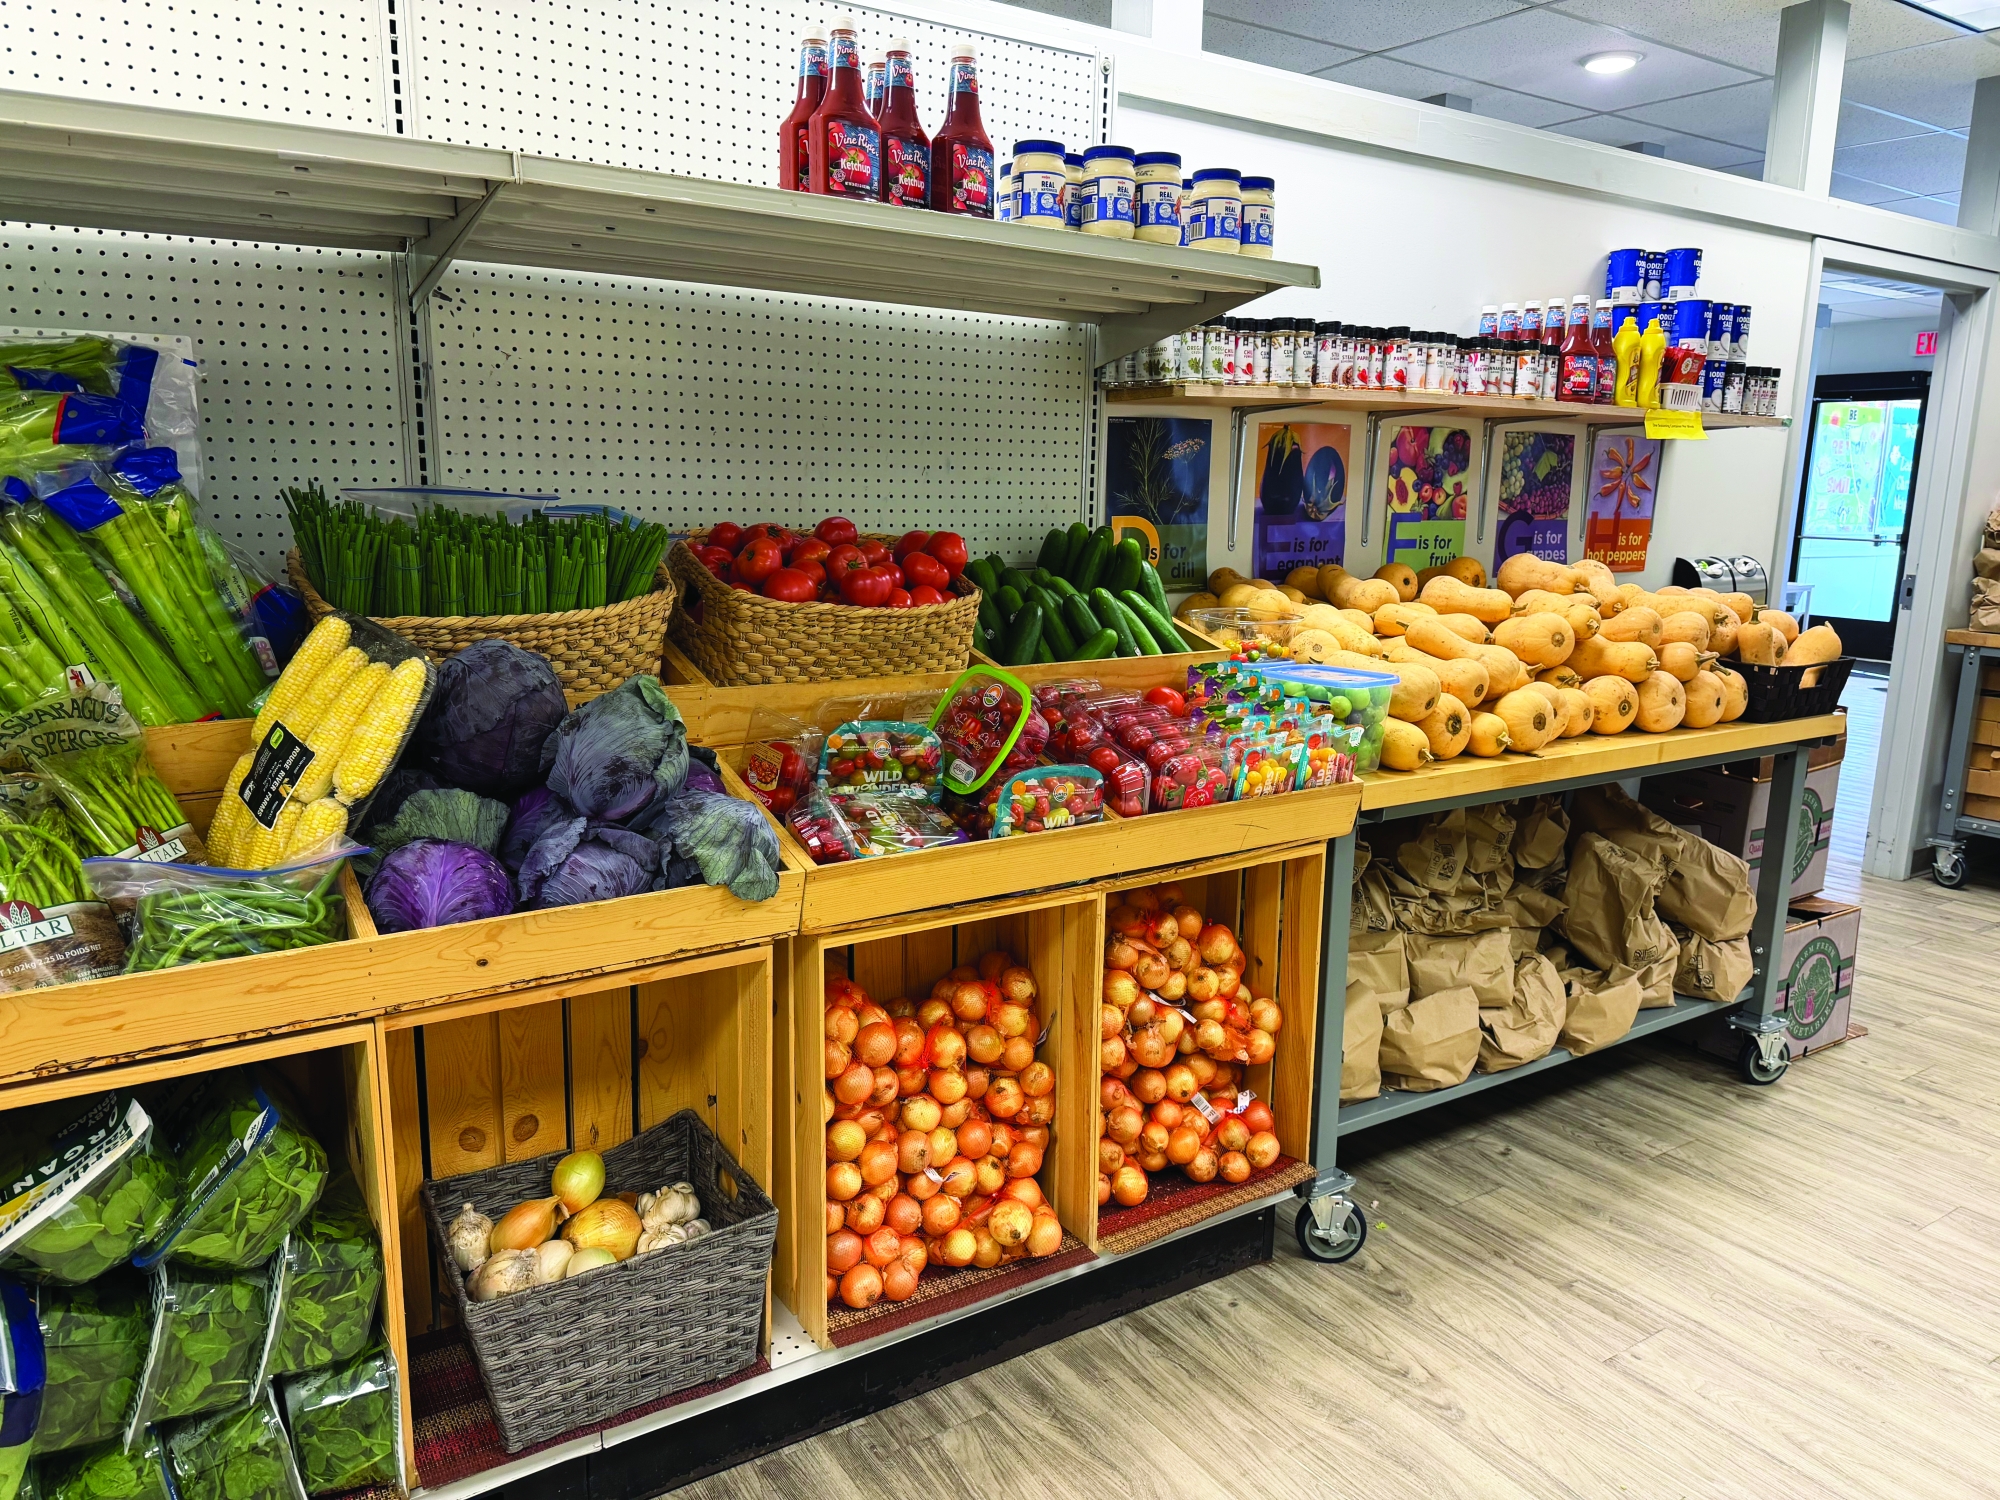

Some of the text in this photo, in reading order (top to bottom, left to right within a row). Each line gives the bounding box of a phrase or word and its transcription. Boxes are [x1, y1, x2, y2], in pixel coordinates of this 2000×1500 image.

[833, 132, 876, 155] Vine Ripe
[840, 158, 870, 177] Ketchup
[892, 150, 929, 170] Vine Ripe
[957, 154, 977, 168] Vine
[898, 174, 924, 191] Ketchup
[962, 178, 988, 196] Ketchup
[1916, 332, 1938, 355] EXI
[1570, 375, 1589, 384] Ketchup
[1849, 410, 1857, 420] BE
[1293, 538, 1305, 552] is
[1309, 537, 1329, 553] for
[1418, 536, 1429, 549] is
[1433, 535, 1452, 549] for
[1534, 532, 1542, 544] is
[1546, 531, 1562, 544] for
[1588, 511, 1642, 566] H is for
[1145, 544, 1158, 560] is
[1164, 543, 1187, 559] for
[1429, 551, 1457, 566] fruit
[1587, 549, 1646, 564] hot peppers
[1171, 563, 1195, 579] dill
[1277, 554, 1341, 572] eggplant
[17, 729, 128, 768] ASPERGES
[284, 746, 301, 771] ROUGE
[271, 770, 286, 792] RIVER
[863, 770, 902, 782] WILD
[1316, 769, 1325, 786] ILD
[257, 791, 272, 817] FARMS
[1804, 794, 1818, 809] RESH
[1043, 815, 1075, 829] WILD
[0, 919, 66, 948] LTAR
[6, 962, 36, 976] 1.02kg
[38, 956, 55, 966] 2.25
[64, 947, 90, 959] POIDS
[1796, 942, 1836, 969] FARM FRESH
[1788, 999, 1834, 1036] VEGETABLES
[12, 1106, 118, 1194] ORGAN
